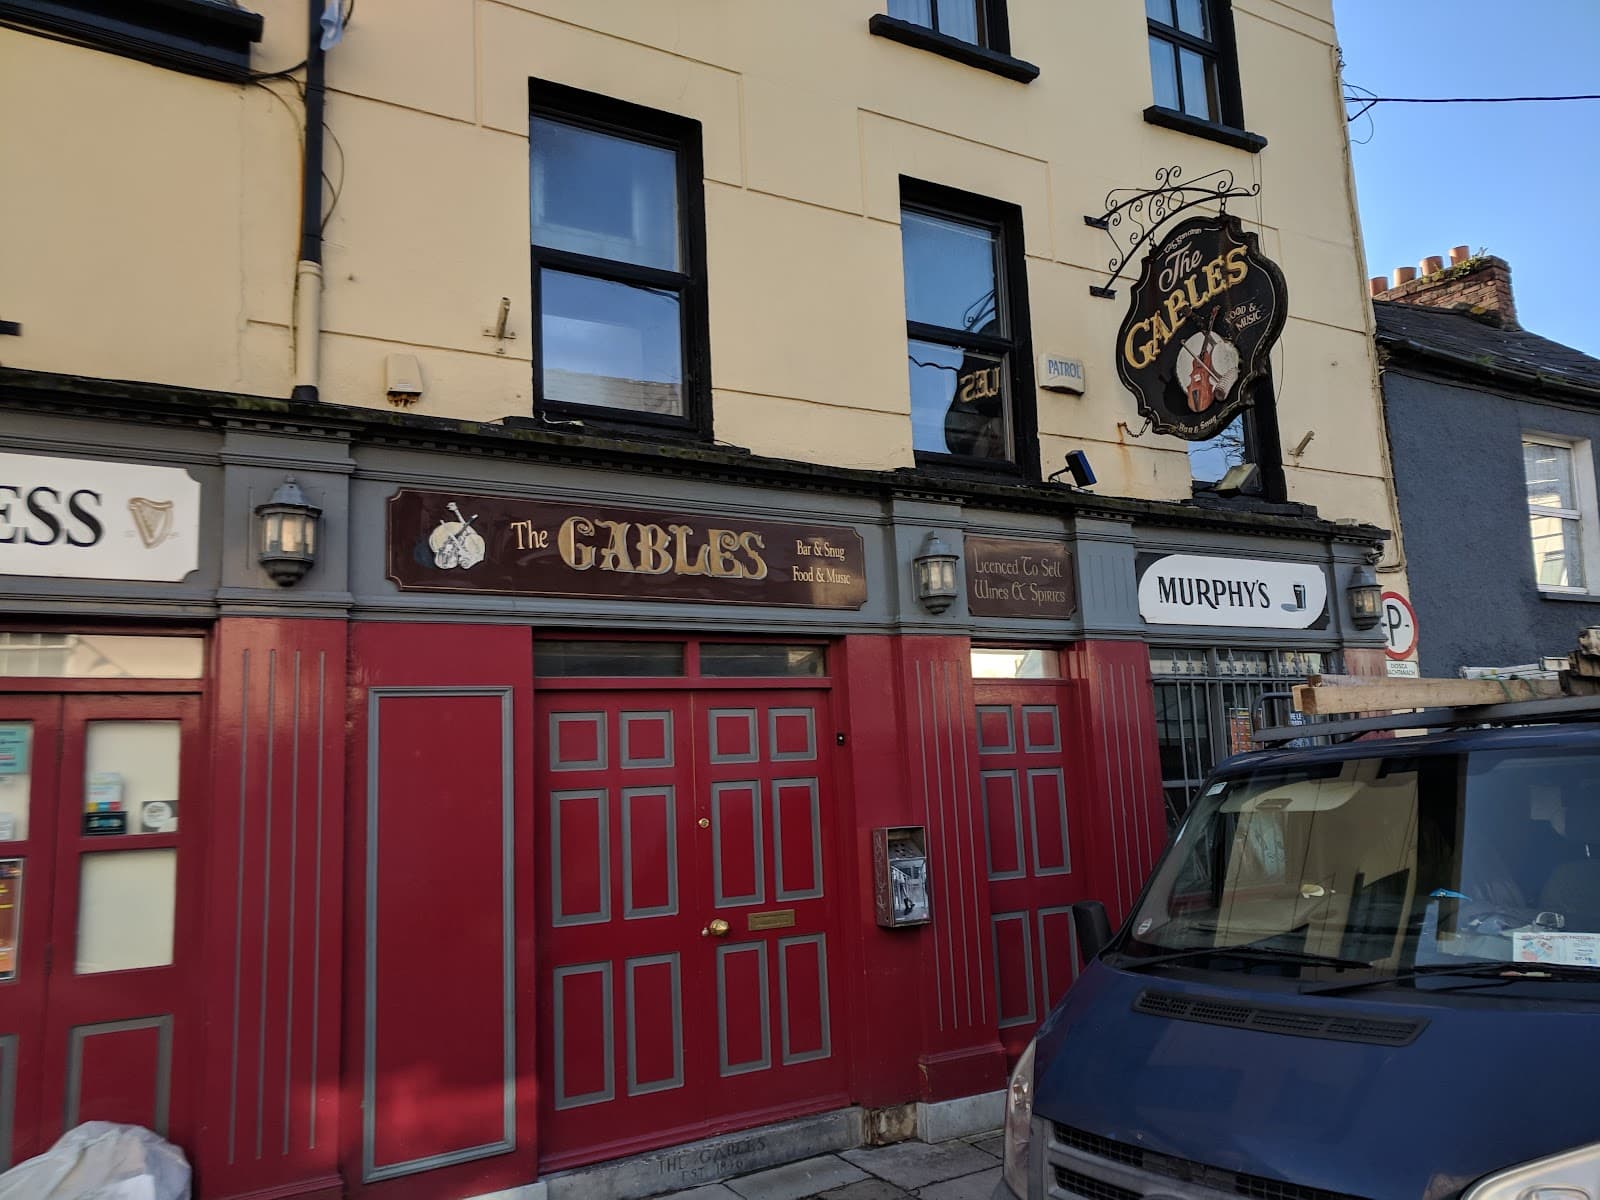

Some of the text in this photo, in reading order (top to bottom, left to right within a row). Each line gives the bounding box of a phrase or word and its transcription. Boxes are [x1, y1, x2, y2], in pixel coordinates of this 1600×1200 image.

[1158, 241, 1203, 292] The
[1124, 245, 1249, 370] GABLES
[1235, 310, 1262, 331] MUSIC
[1048, 359, 1082, 379] PATROL
[511, 515, 768, 580] The GABLES
[796, 540, 846, 562] Bar & Snug
[792, 565, 851, 585] Food & Music
[974, 548, 1063, 578] Licenced To Sell
[974, 579, 1009, 600] Wines
[1011, 581, 1026, 601] &
[1157, 576, 1271, 609] MURPHY'S
